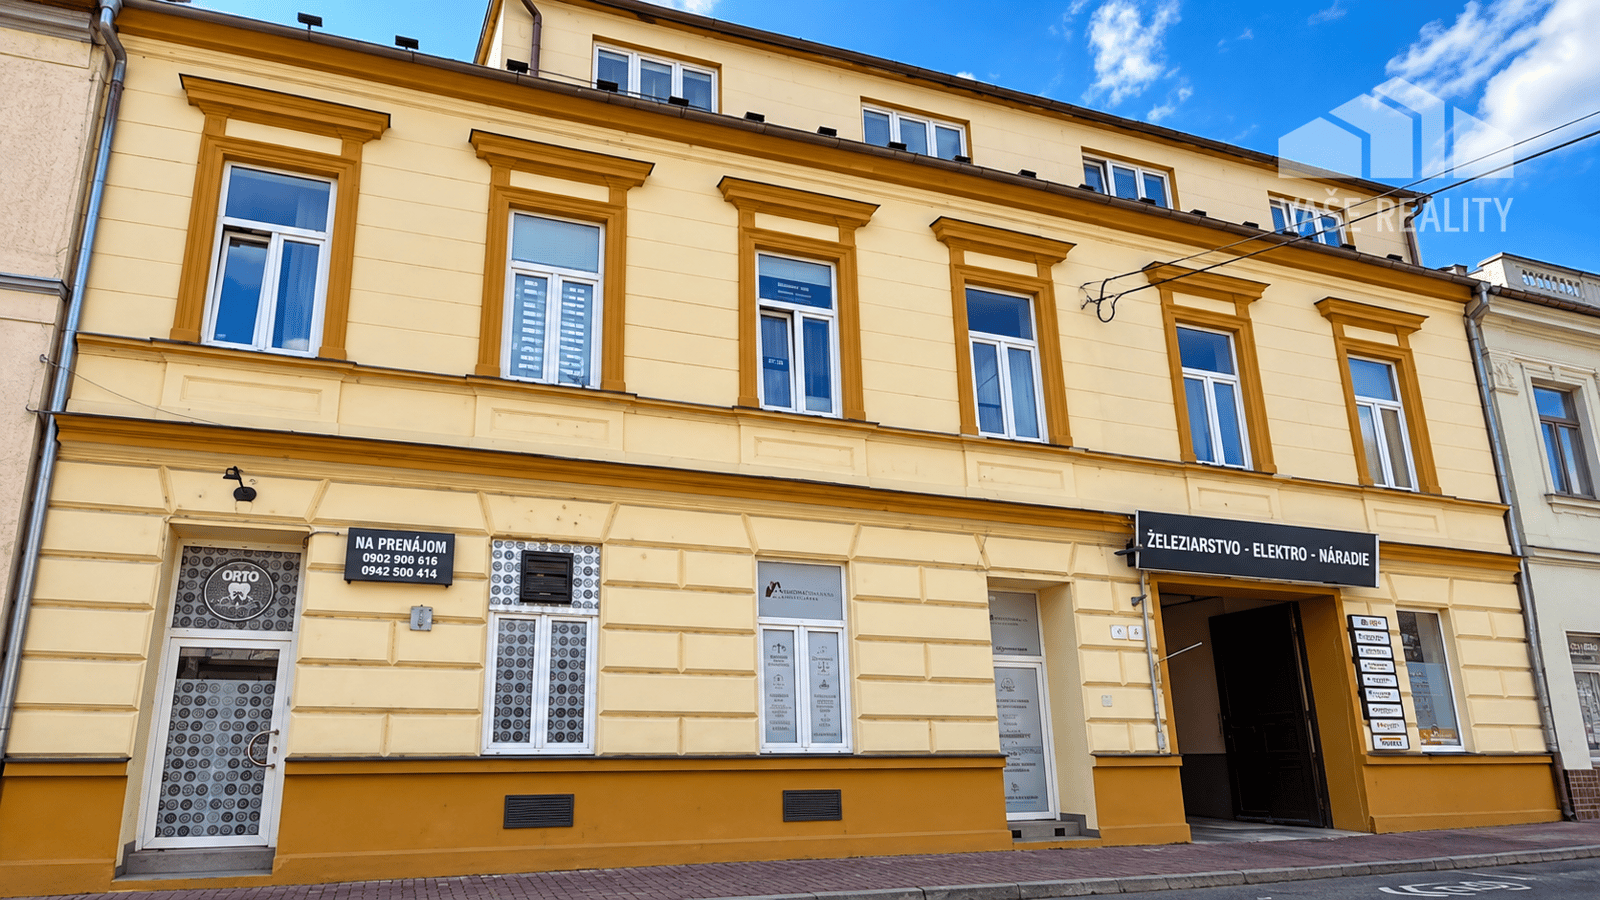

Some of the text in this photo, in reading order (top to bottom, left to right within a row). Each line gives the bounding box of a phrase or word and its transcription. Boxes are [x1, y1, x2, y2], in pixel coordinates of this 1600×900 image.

[355, 536, 446, 553] NA PRENÁJOM
[1147, 529, 1241, 555] ŽELEZIARSTVO
[1253, 542, 1307, 562] ELEKTRO
[1319, 545, 1370, 567] NÁRADIE
[363, 553, 391, 563] 0902
[418, 556, 438, 565] 616
[222, 570, 259, 582] ORTO
[362, 566, 390, 576] 0942
[416, 569, 437, 578] 414
